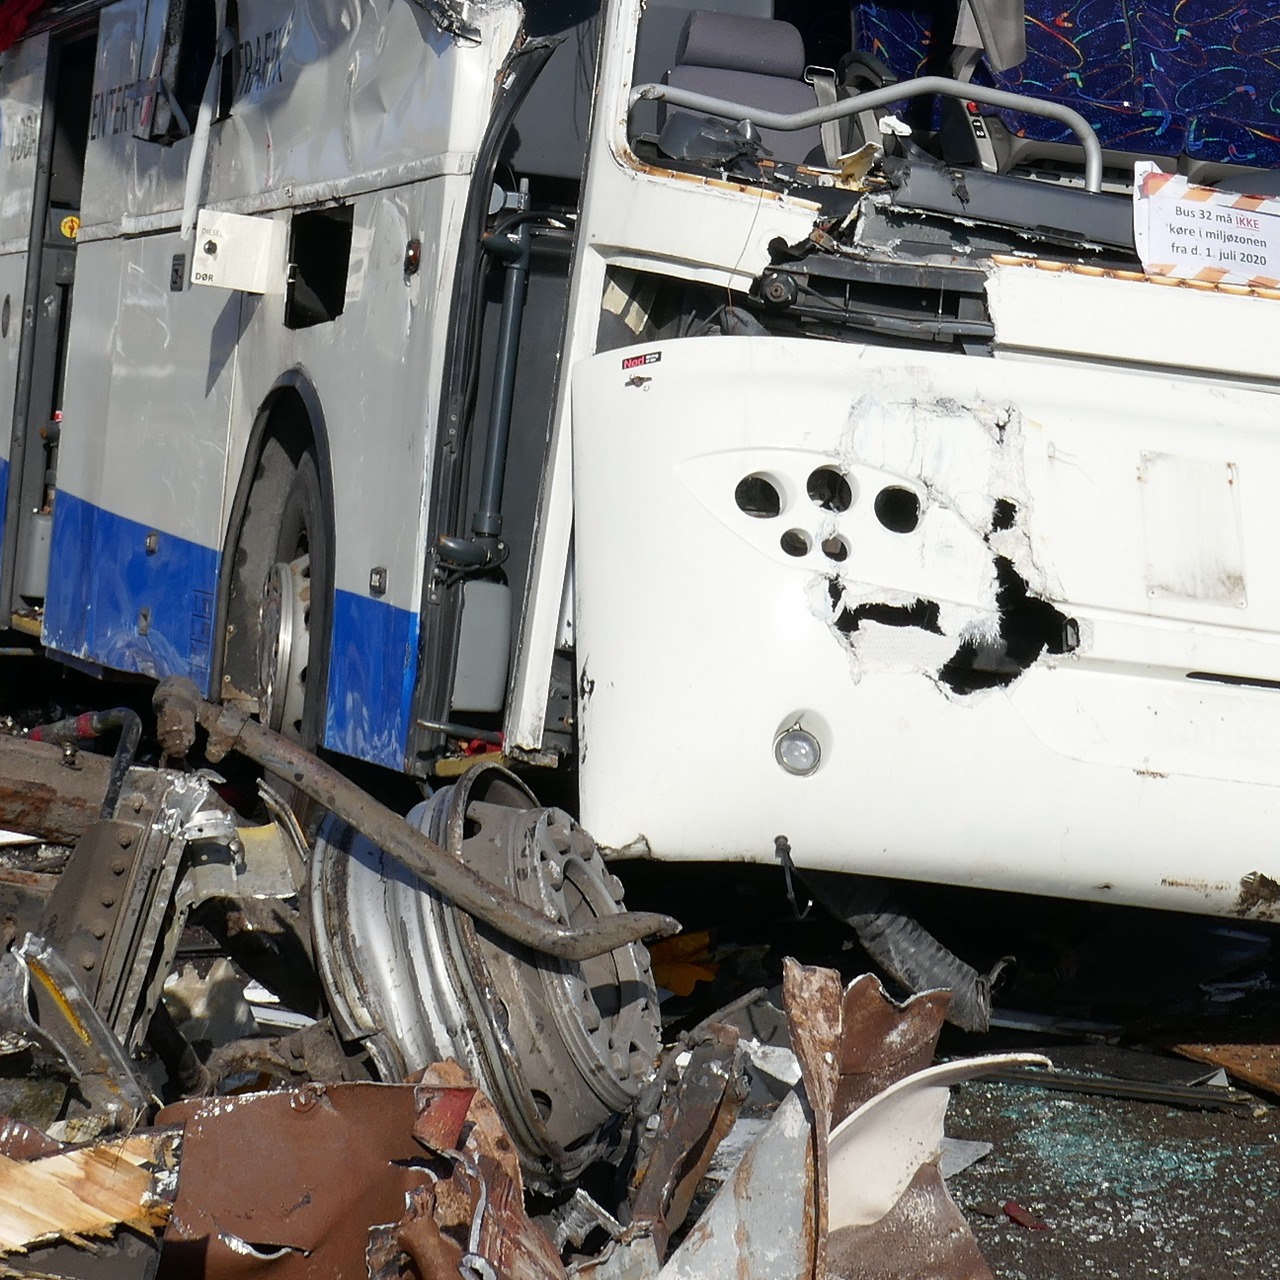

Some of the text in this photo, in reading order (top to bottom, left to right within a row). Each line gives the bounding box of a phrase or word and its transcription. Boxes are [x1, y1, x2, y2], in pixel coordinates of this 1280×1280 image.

[1175, 206, 1260, 230] Bus 32 må IKKE
[201, 227, 223, 238] DIESEL
[1169, 223, 1196, 237] køre
[1205, 229, 1267, 248] miljøzonen
[1171, 243, 1267, 266] fra d. 1. juli 2020
[195, 272, 214, 282] DØR
